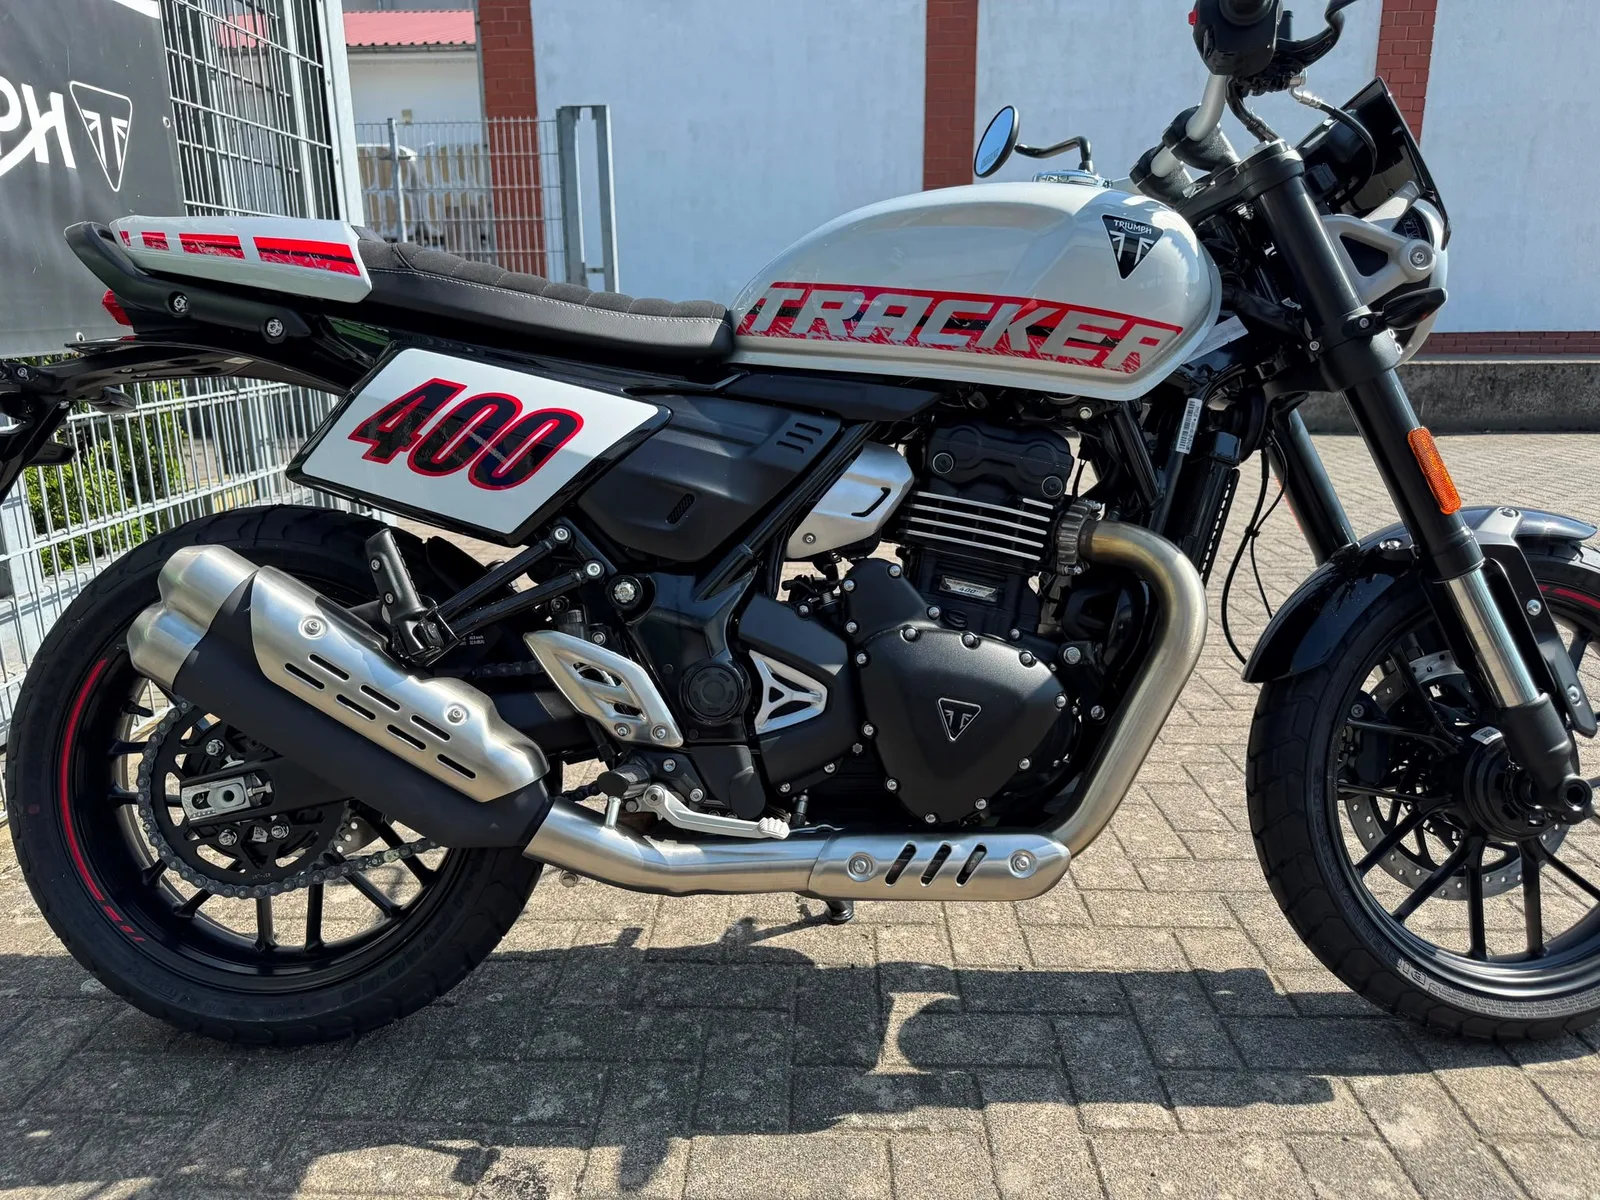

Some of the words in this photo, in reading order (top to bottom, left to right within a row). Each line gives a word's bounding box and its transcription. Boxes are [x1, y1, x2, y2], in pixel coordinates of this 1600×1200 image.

[1113, 219, 1152, 235] TRIUMPH
[747, 287, 1180, 368] TRACKER
[347, 376, 585, 491] 400
